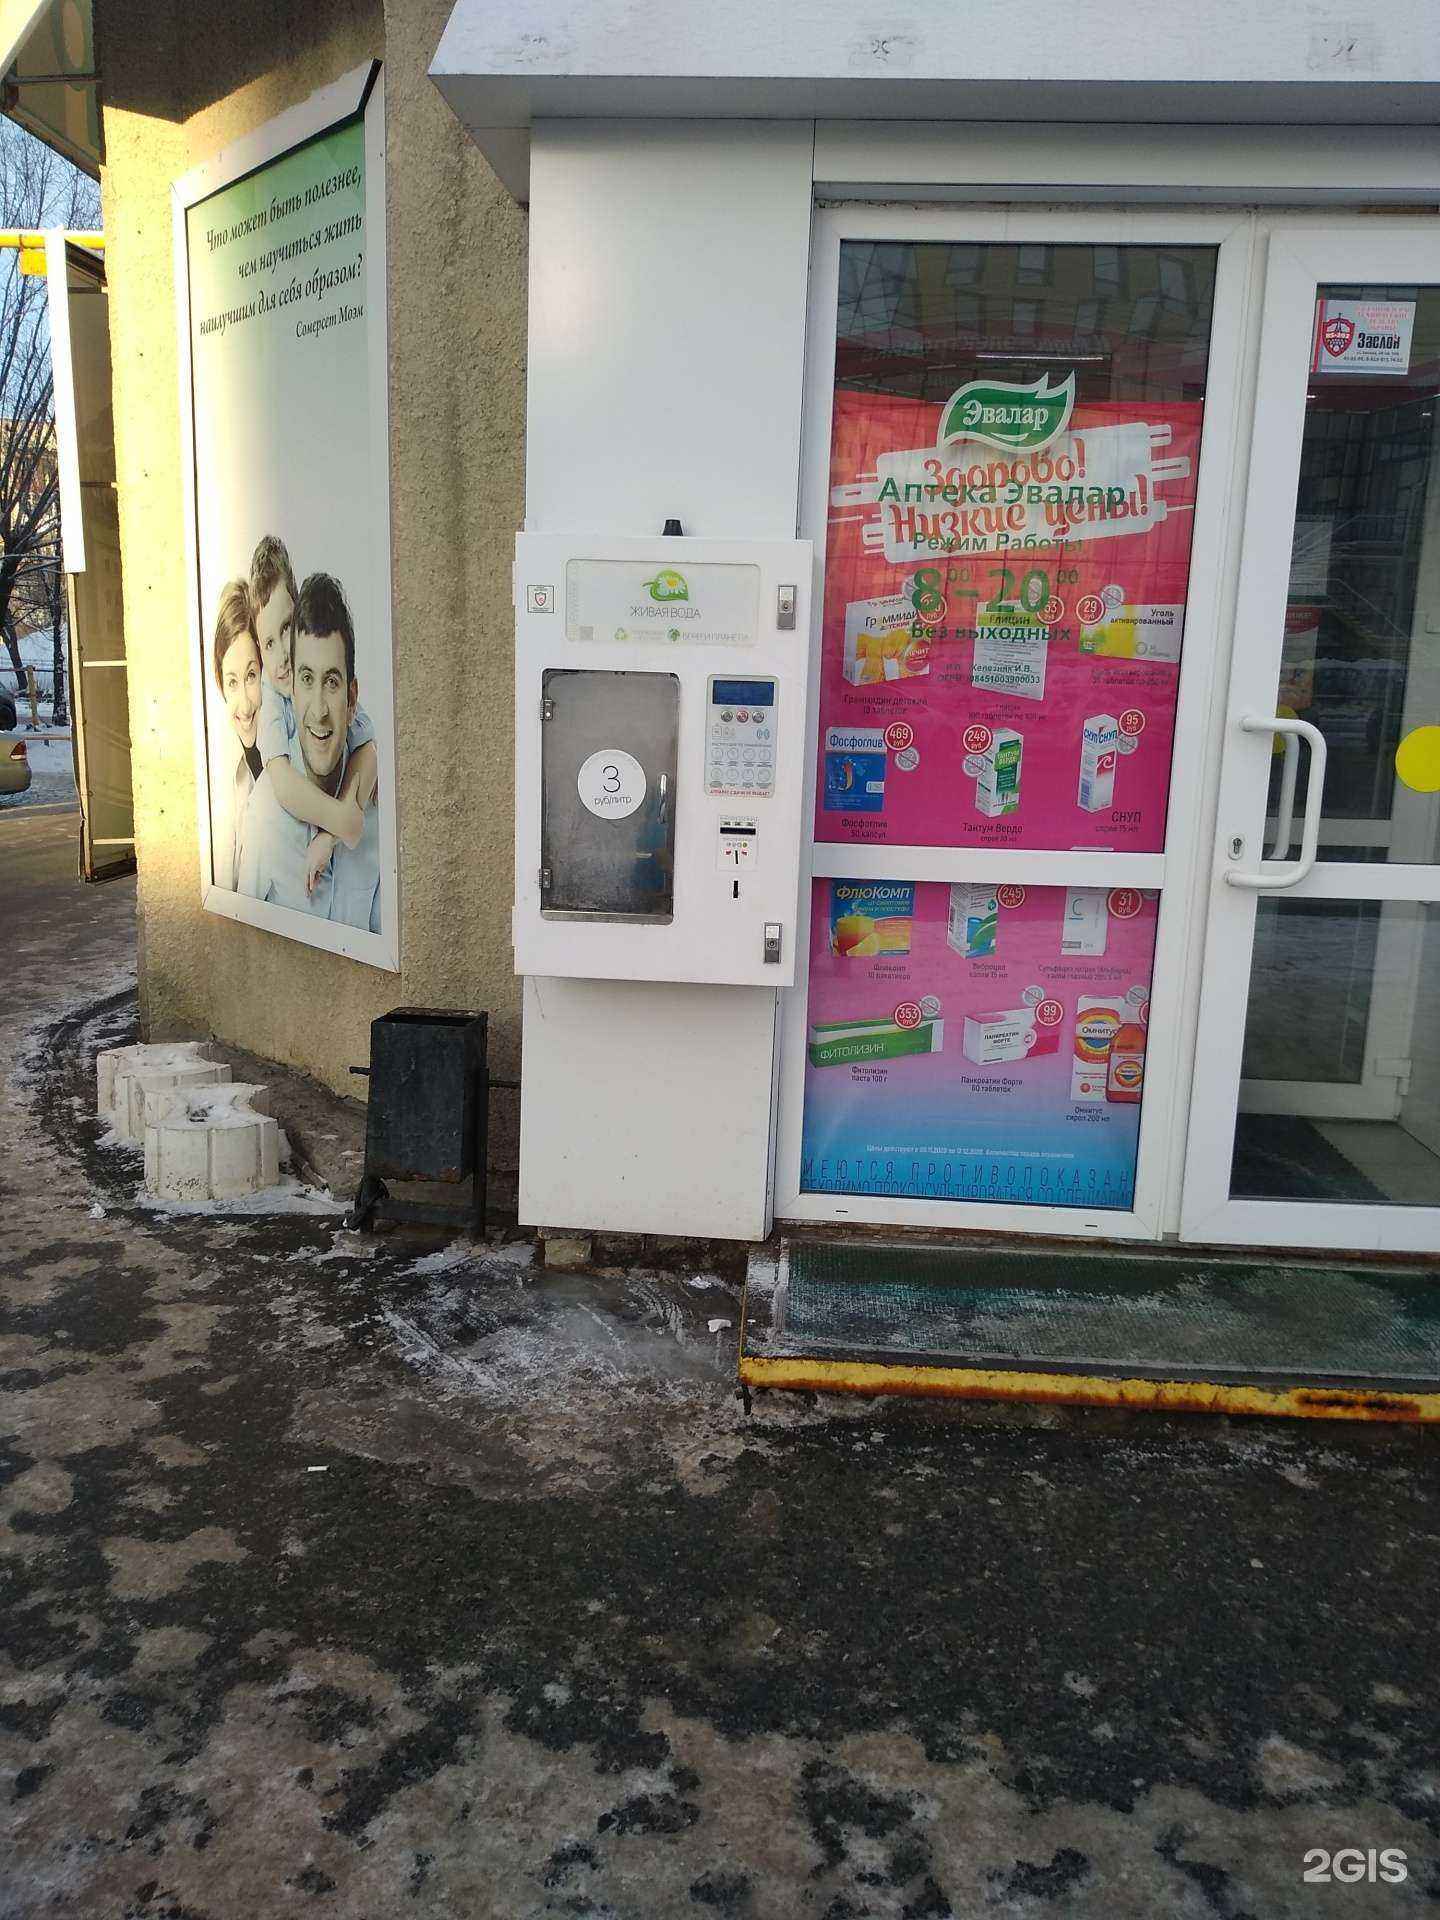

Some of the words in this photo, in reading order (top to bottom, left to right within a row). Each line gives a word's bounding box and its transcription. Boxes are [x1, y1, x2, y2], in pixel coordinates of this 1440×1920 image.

[206, 230, 229, 252] Что
[230, 210, 267, 243] может
[270, 195, 302, 226] быть
[305, 165, 362, 207] полезнее,
[238, 259, 257, 280] чем
[259, 232, 321, 274] научиться
[323, 213, 362, 246] жить
[200, 303, 256, 336] наилучшим
[258, 290, 276, 315] для
[279, 276, 302, 308] себя
[305, 253, 363, 301] образом?
[296, 313, 338, 338] Сомерсет
[338, 304, 364, 325] Моэм
[1357, 332, 1401, 350] Заслон
[962, 401, 1049, 431] Эвалар
[923, 438, 1087, 508] Здорово!
[877, 477, 997, 503] Аптека
[1004, 480, 1125, 514] Эвалар
[890, 501, 1026, 553] Низкие
[1045, 474, 1148, 538] цены!
[913, 532, 988, 552] Режим
[995, 532, 1084, 552] Работы
[630, 606, 669, 618] ЖИВАЯ
[670, 607, 701, 619] ВОДА
[1083, 600, 1098, 613] 29
[1151, 608, 1175, 617] Уголь
[1110, 617, 1174, 626] активированный
[910, 623, 950, 640] Без
[955, 626, 1071, 643] выходных
[1126, 714, 1139, 726] 95
[889, 728, 909, 740] 469
[967, 730, 986, 742] 249
[1099, 729, 1118, 744] СНУП
[829, 735, 883, 749] Фосфоглив
[602, 765, 621, 793] 3
[593, 795, 632, 808] руб/литр
[842, 818, 888, 830] Фосфоглив
[1111, 811, 1142, 824] СНУП
[962, 822, 993, 834] Тантум
[1002, 887, 1021, 899] 245
[1119, 892, 1132, 906] 31
[899, 1007, 918, 1020] 353
[1081, 1025, 1118, 1037] Омнитус
[820, 1043, 885, 1060] ФИТОЛИЗИН
[851, 1065, 888, 1076] Фитолизин
[1074, 1106, 1103, 1115] Омнитус
